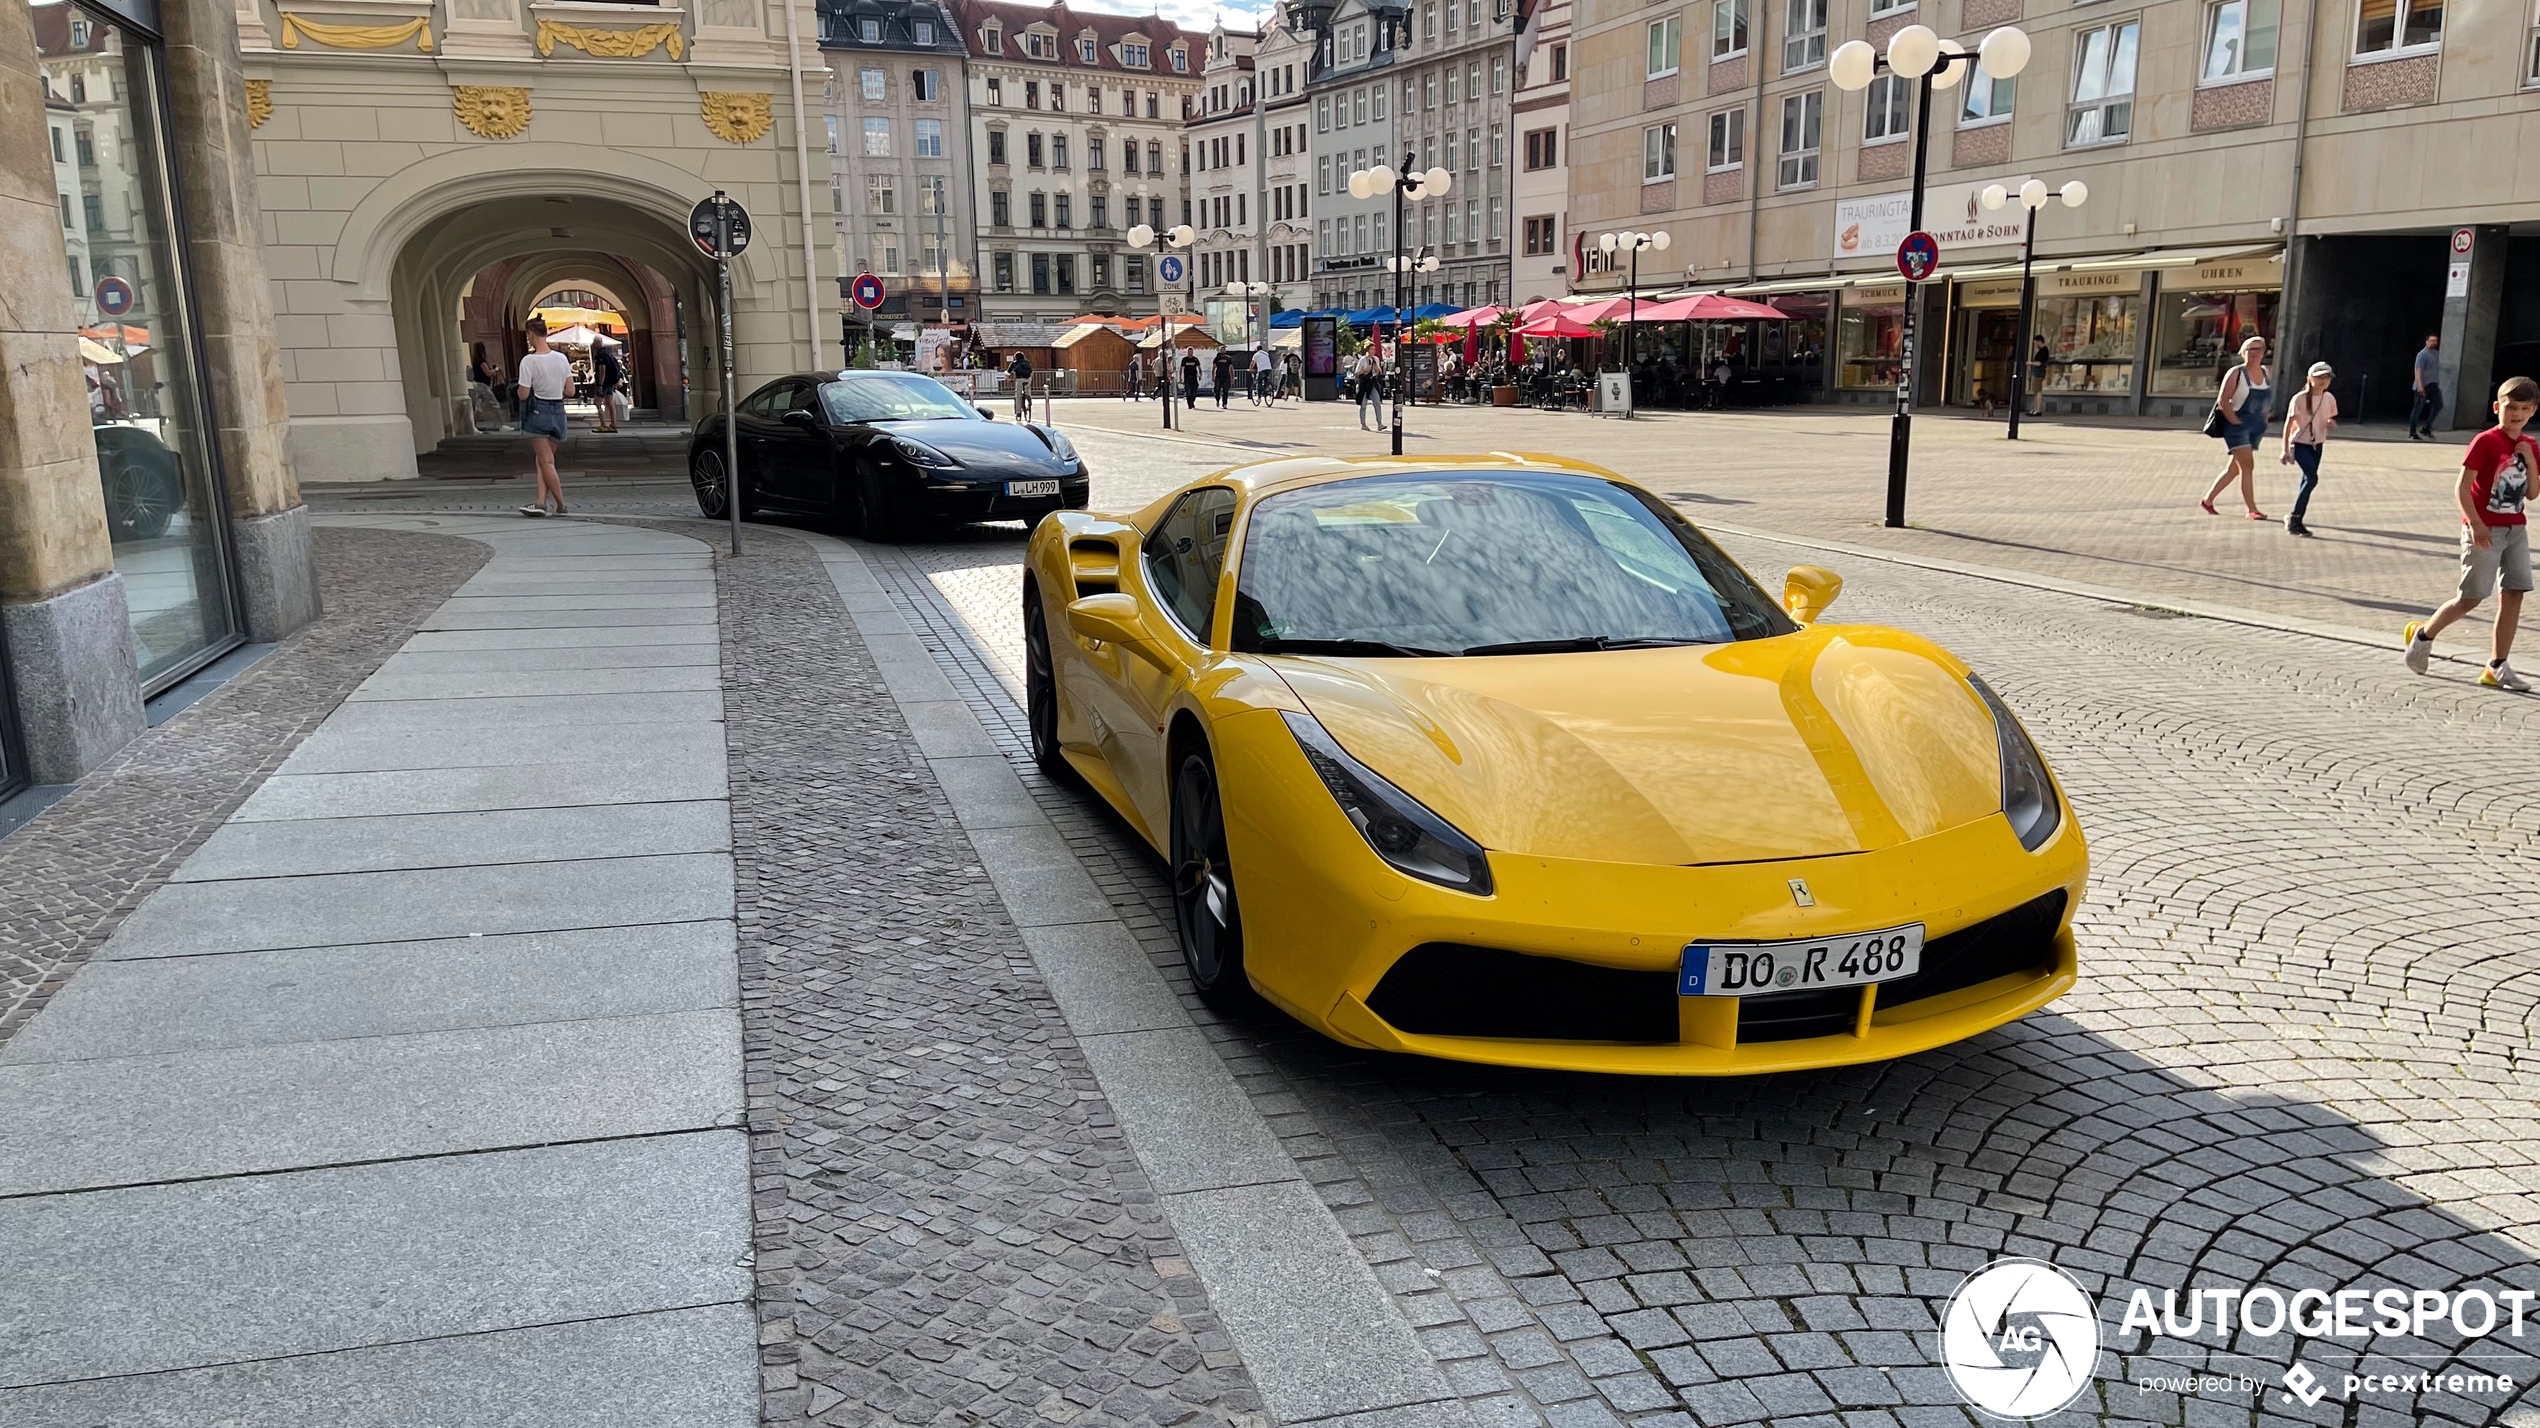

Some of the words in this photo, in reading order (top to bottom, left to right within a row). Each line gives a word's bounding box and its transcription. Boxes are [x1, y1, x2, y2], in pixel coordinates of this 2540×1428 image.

[1977, 228, 1985, 239] &
[1986, 224, 2020, 238] SOHN
[1861, 236, 1872, 249] ab
[2201, 267, 2243, 279] UHREN
[2058, 274, 2120, 288] TRAURINGE
[1860, 288, 1898, 298] SCHMUCK
[1013, 483, 1019, 494] L
[1025, 482, 1038, 494] LH
[1040, 481, 1056, 493] 999
[1688, 975, 1698, 986] D
[1721, 952, 1775, 989] DO
[1802, 947, 1829, 983] R
[1838, 935, 1906, 978] 488
